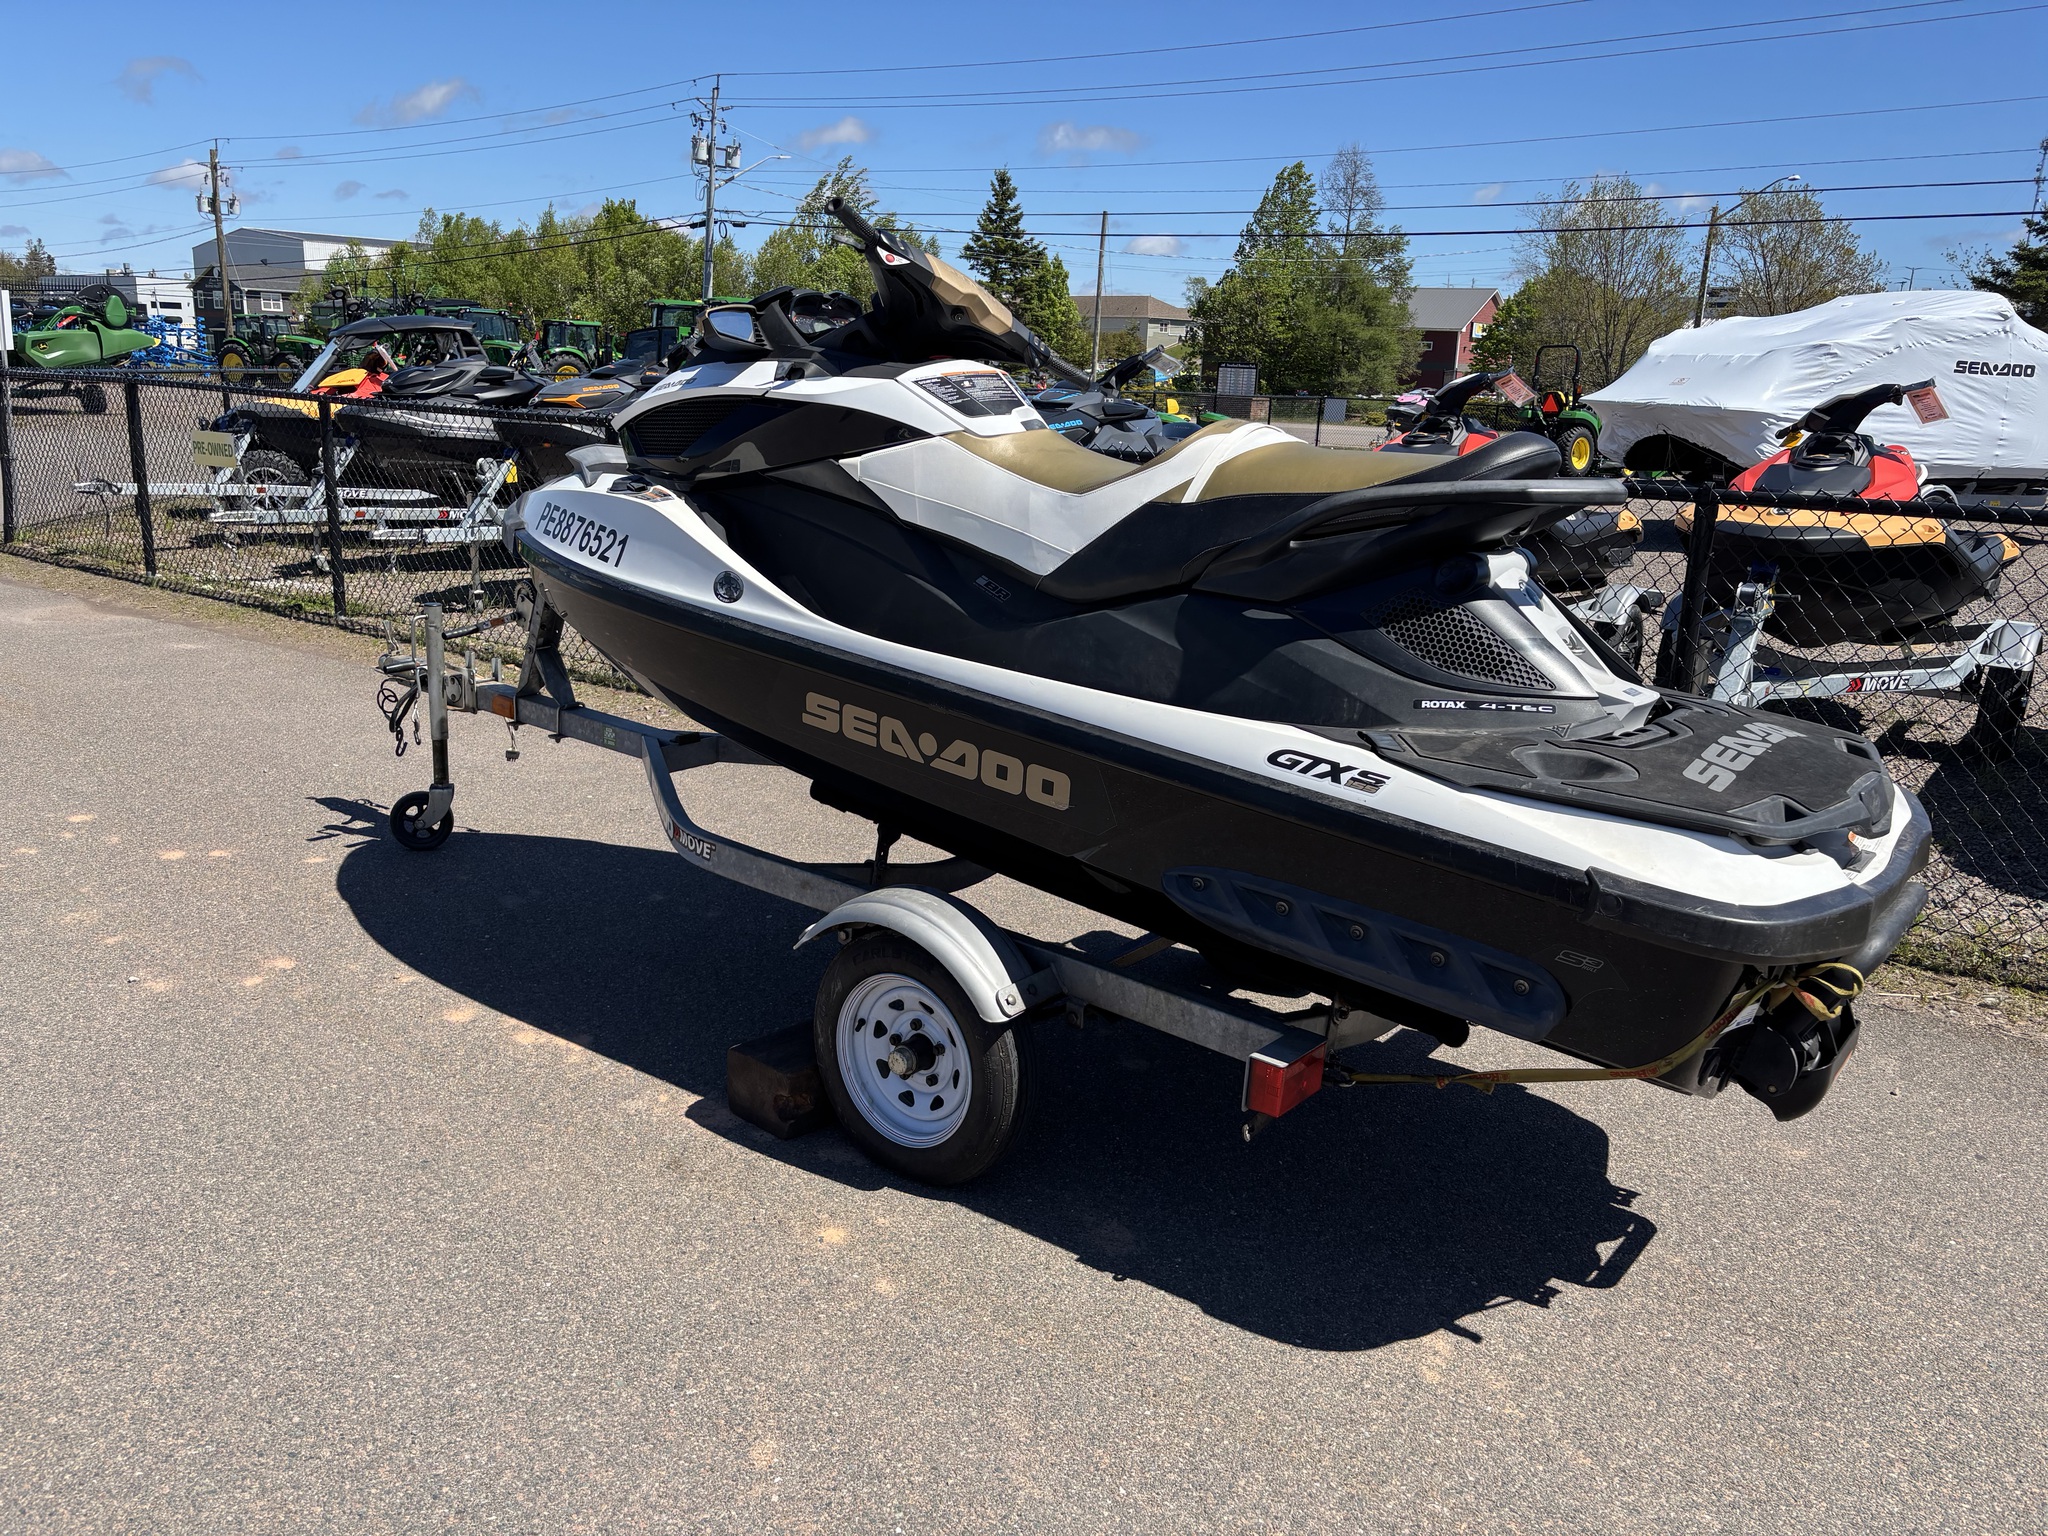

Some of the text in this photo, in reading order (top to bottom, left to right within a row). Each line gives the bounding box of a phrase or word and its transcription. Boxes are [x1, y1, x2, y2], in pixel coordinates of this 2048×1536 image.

[193, 440, 234, 458] PRE-OWNED
[535, 501, 630, 568] PE8876521
[1861, 675, 1911, 692] MOVE
[1421, 700, 1553, 713] ROTAX 4-TEC
[680, 829, 711, 859] MOVE
